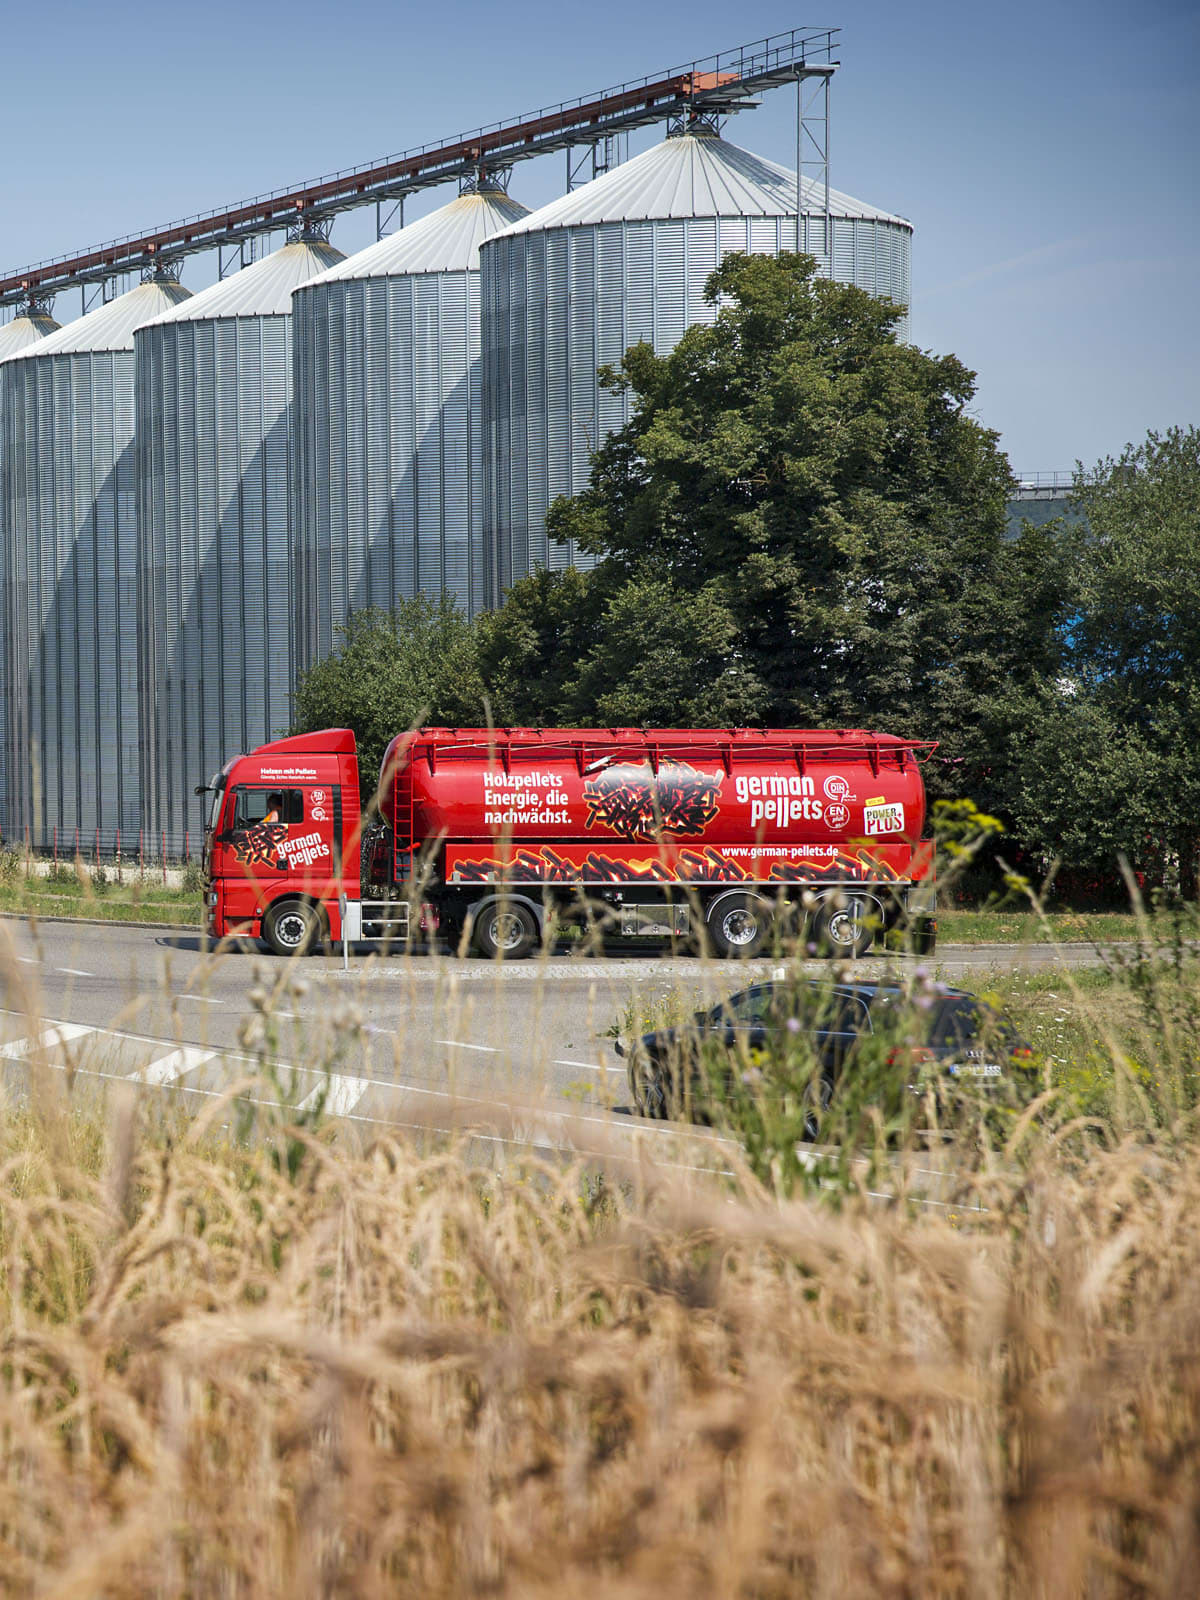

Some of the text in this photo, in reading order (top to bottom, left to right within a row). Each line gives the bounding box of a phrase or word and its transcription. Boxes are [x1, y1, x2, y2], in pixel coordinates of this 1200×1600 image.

[483, 772, 563, 790] Holzpellets
[736, 776, 815, 803] german
[831, 783, 845, 793] DIN
[484, 789, 569, 809] Energie, die
[484, 808, 572, 824] nachwächst.
[751, 797, 823, 828] pellets
[829, 806, 845, 816] EN
[866, 808, 897, 820] POWER
[867, 816, 902, 833] PLUS
[277, 832, 322, 859] german
[721, 845, 839, 859] www.german-pellets.de
[288, 844, 330, 870] pellets
